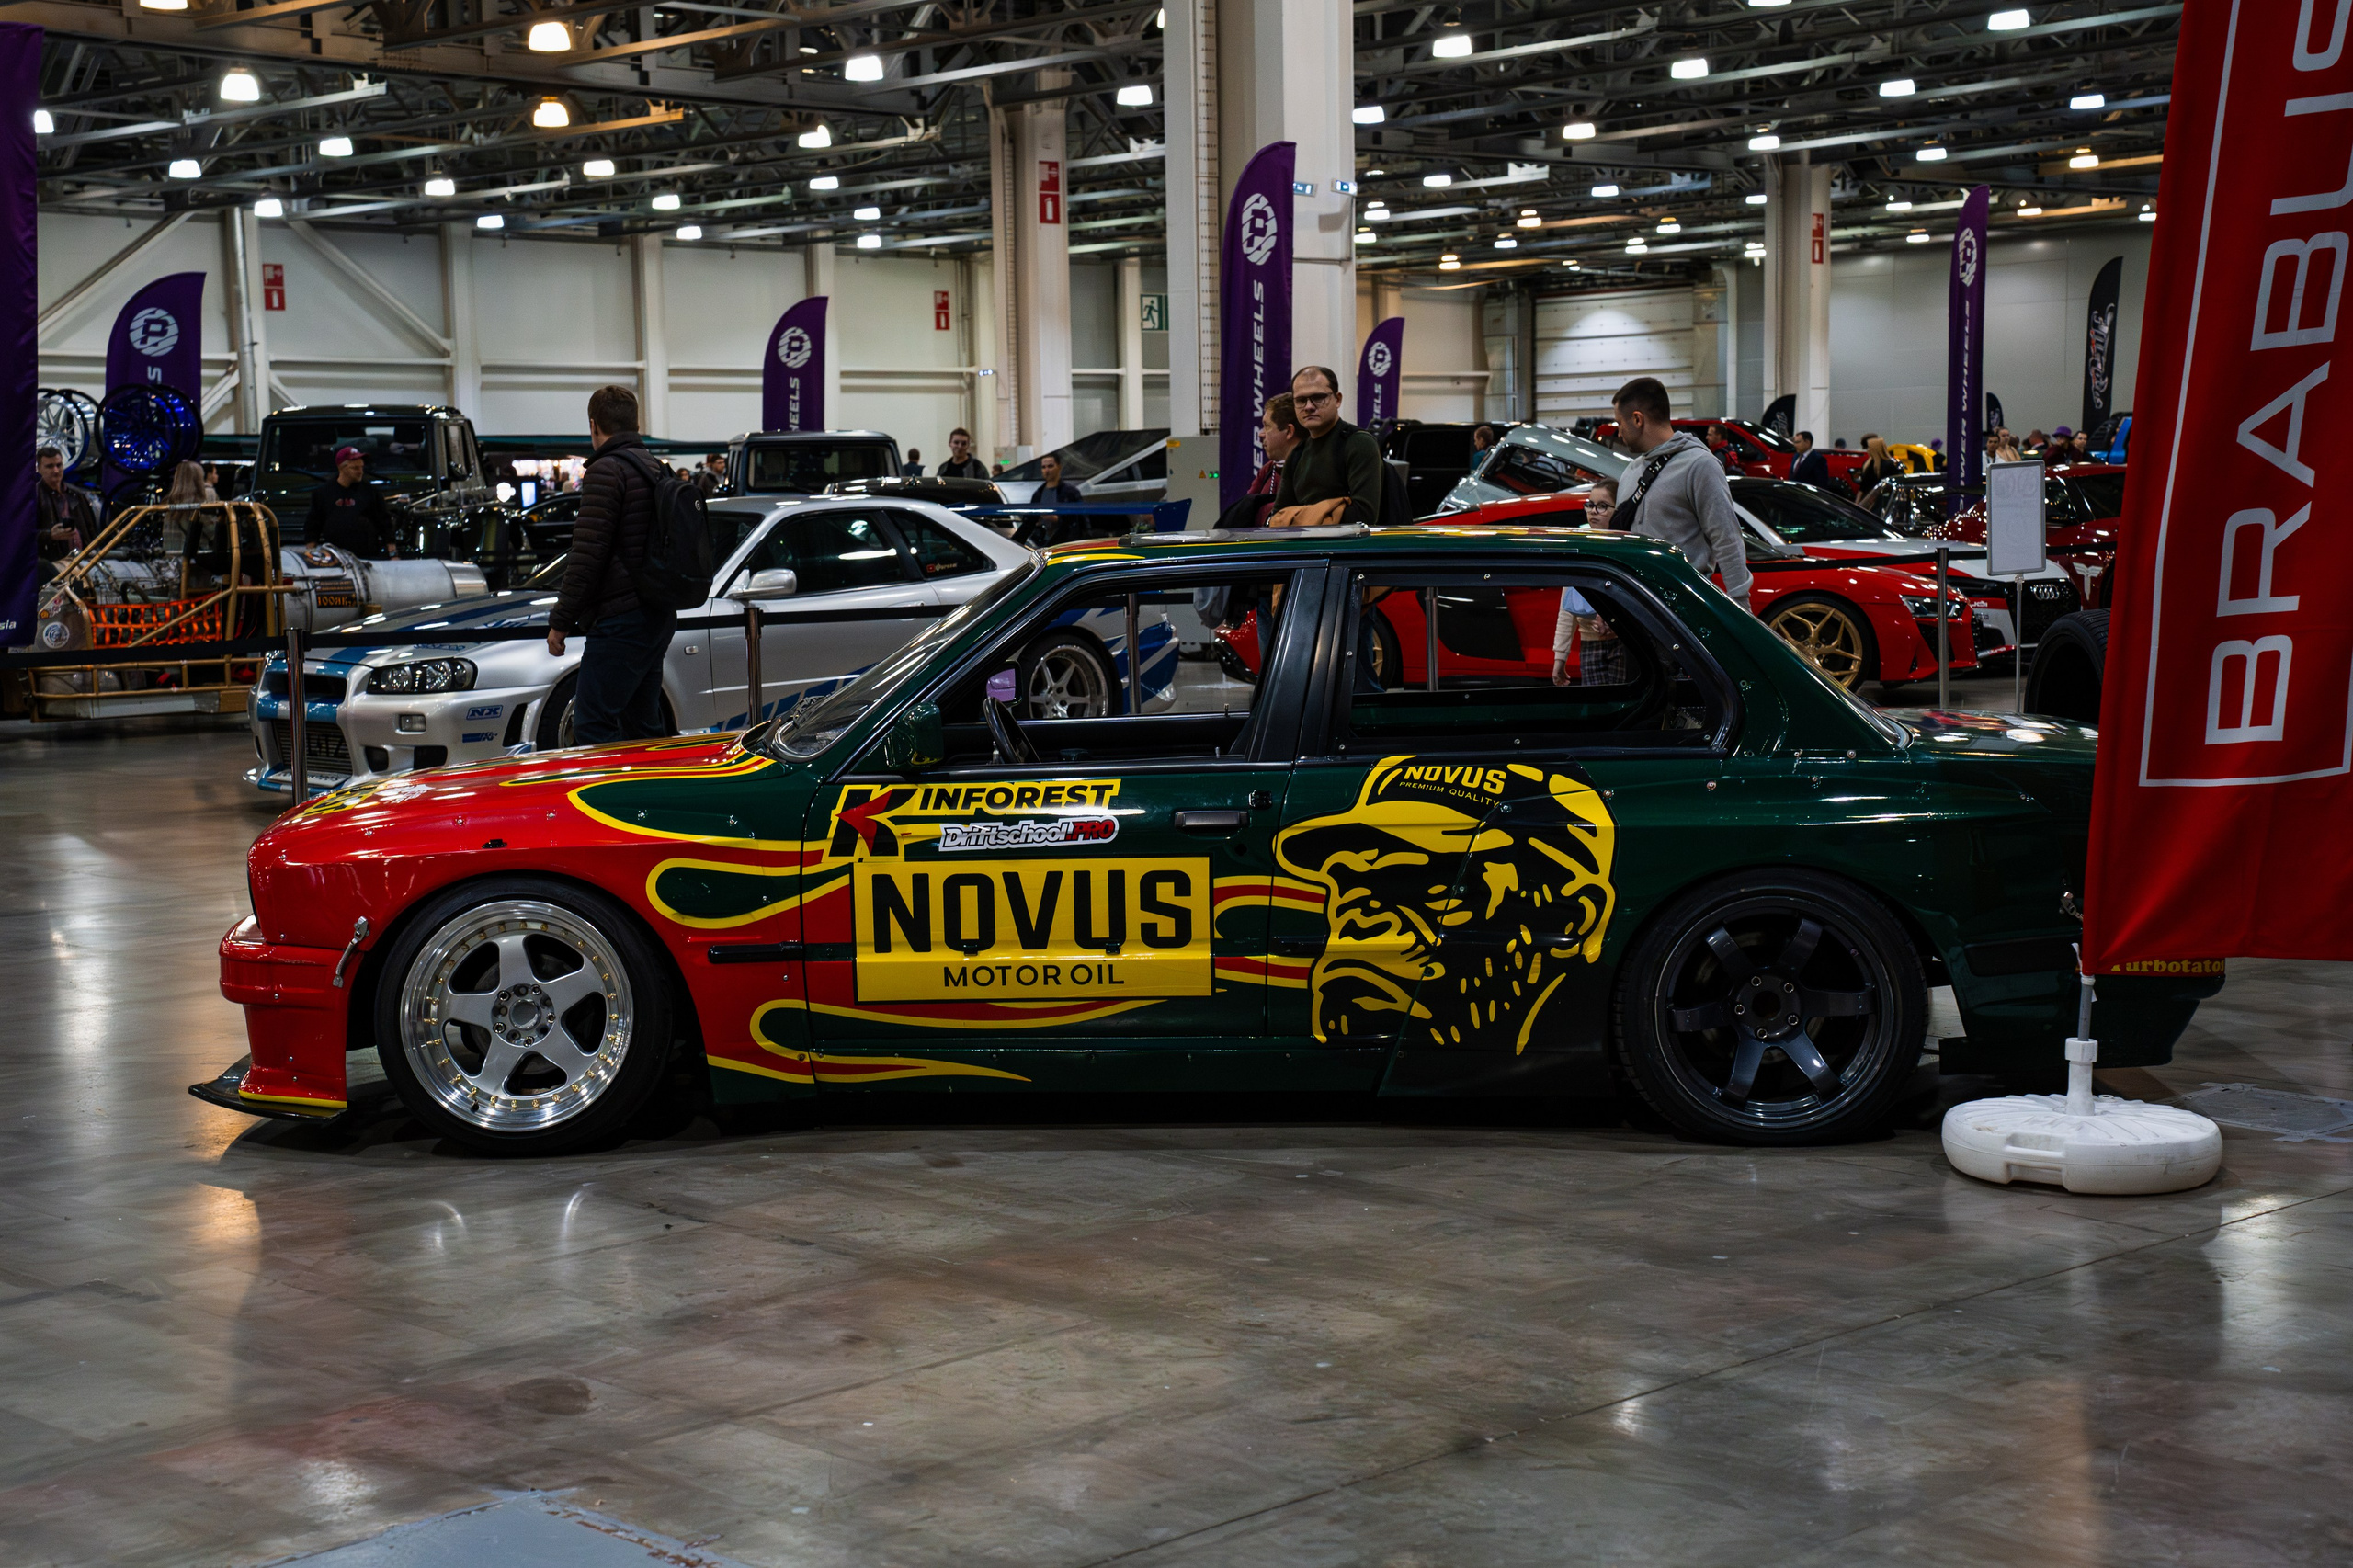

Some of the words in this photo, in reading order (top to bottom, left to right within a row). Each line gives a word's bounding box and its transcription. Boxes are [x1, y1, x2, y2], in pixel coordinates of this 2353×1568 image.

[1253, 279, 1264, 417] WHEELS
[1253, 426, 1264, 477] ER
[1399, 781, 1445, 793] PREMIUM
[1449, 788, 1500, 808] QUALITY
[1404, 766, 1506, 795] NOVUS
[942, 819, 1116, 848] Driftschool.PRO
[871, 870, 1192, 954] NOVUS
[943, 965, 1062, 987] MOTOR
[1070, 963, 1124, 985] OIL
